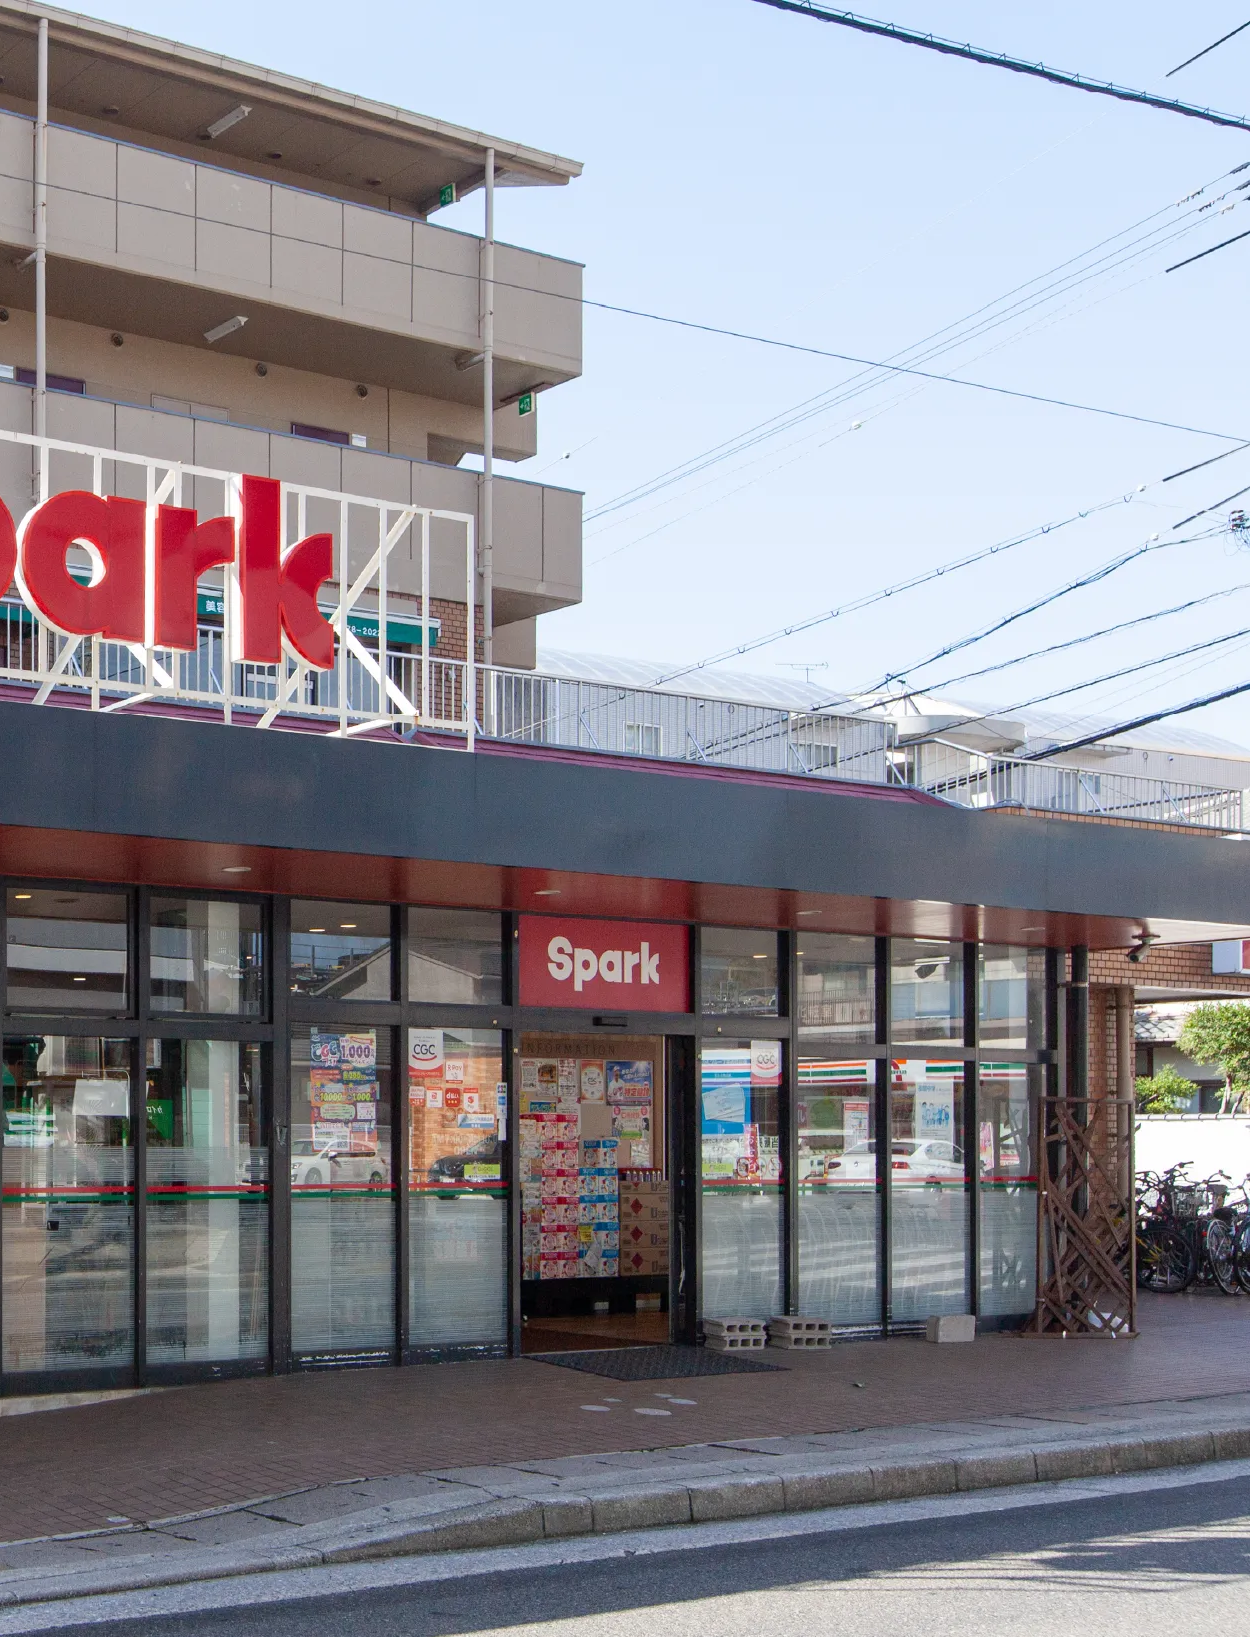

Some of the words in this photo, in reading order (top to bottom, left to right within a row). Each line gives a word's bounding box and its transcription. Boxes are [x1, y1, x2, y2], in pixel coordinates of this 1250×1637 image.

[547, 935, 660, 992] Spark
[413, 1043, 436, 1056] CGC
[757, 1054, 775, 1065] CGC
